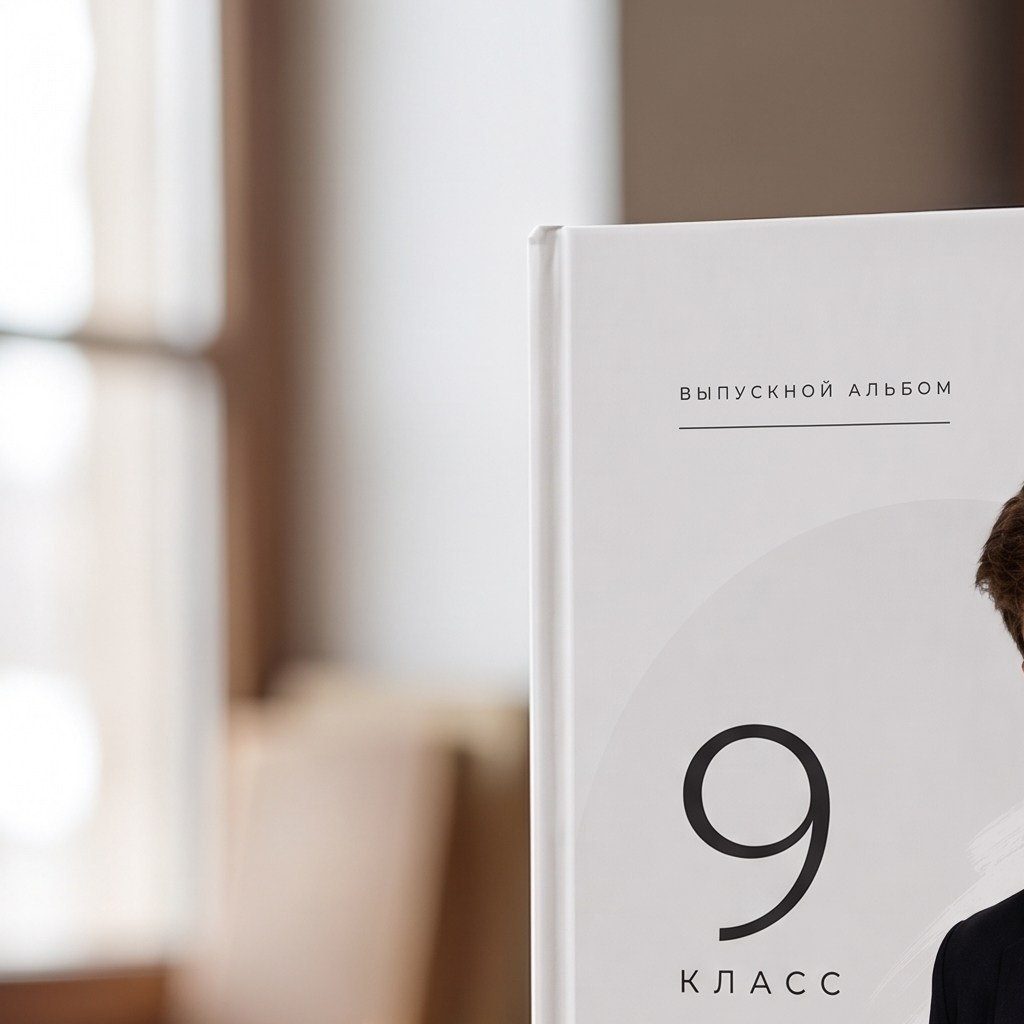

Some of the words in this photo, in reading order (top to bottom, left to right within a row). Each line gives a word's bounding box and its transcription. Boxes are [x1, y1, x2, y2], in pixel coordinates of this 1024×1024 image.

[680, 380, 832, 401] ВЫПУСКНОЙ
[848, 380, 952, 398] АЛЬБОМ
[682, 723, 831, 942] 9
[680, 969, 841, 996] КЛАСС
